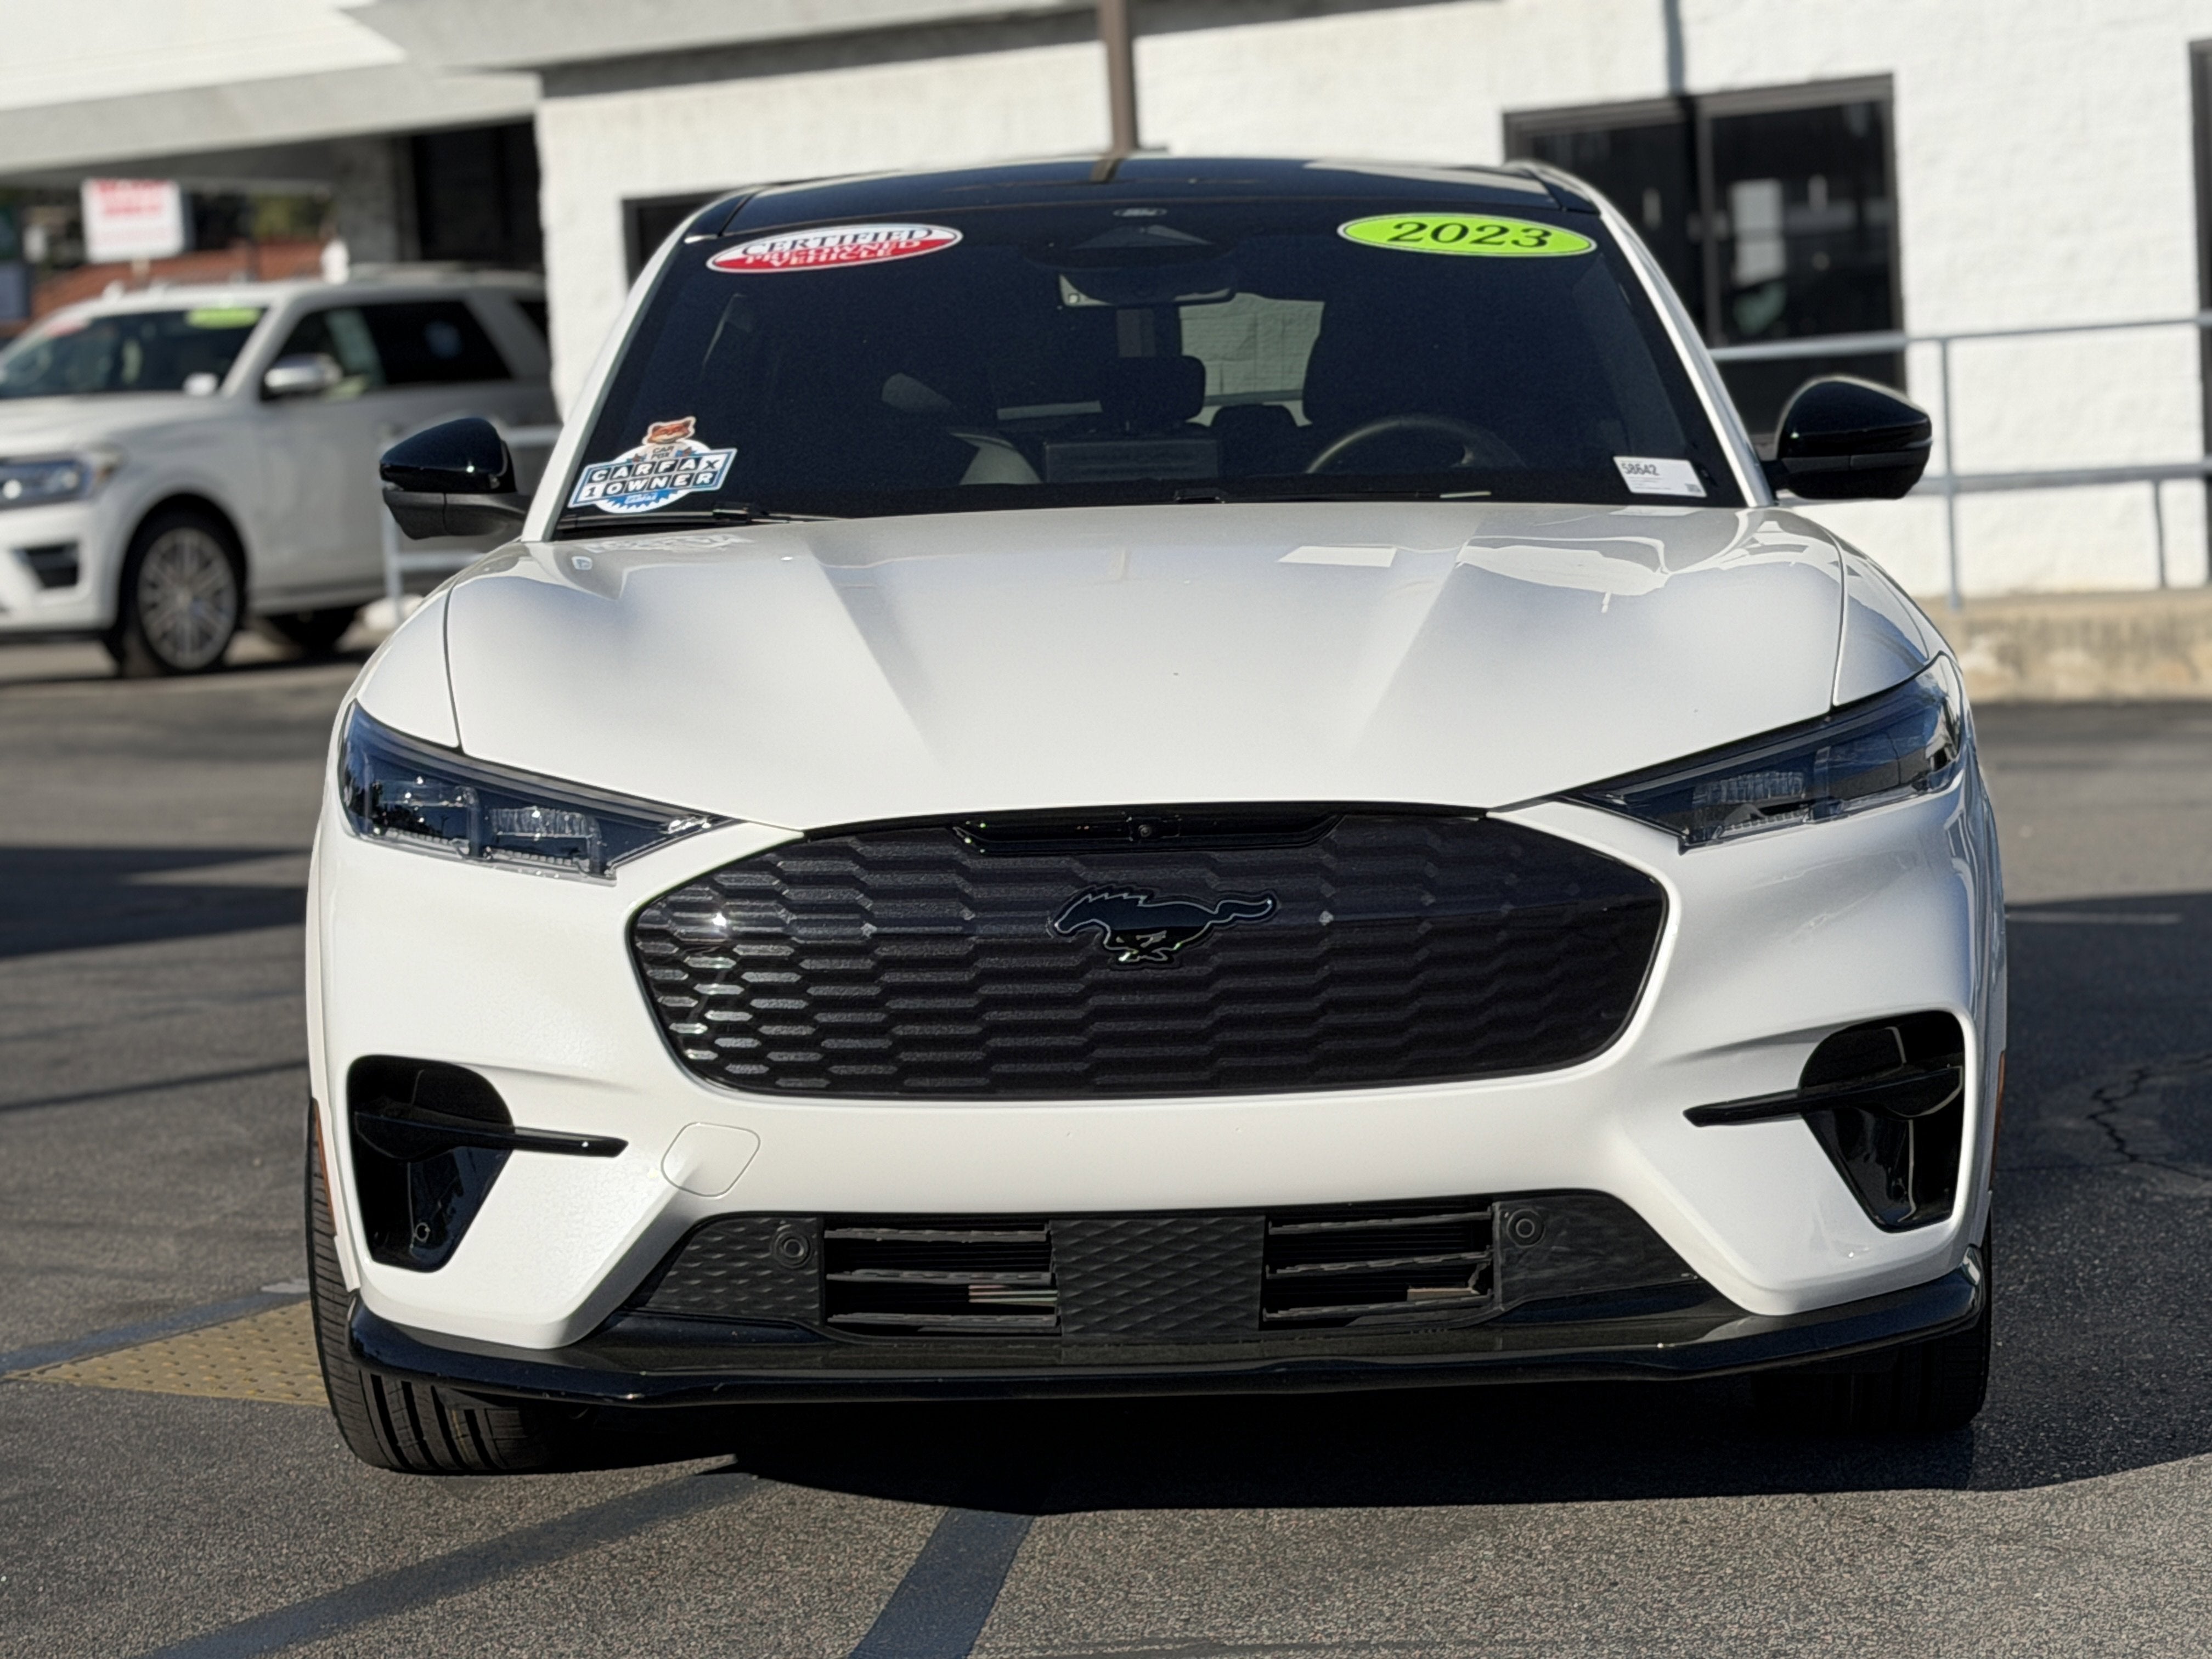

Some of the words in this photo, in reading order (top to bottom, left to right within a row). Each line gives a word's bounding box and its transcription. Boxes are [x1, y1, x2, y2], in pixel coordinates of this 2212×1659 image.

[742, 228, 932, 256] CERTIFIED
[1387, 221, 1553, 248] 2023
[769, 248, 894, 267] VEHICLE
[591, 459, 720, 482] CARFAX
[584, 486, 597, 498] 1
[606, 472, 714, 494] OWNER
